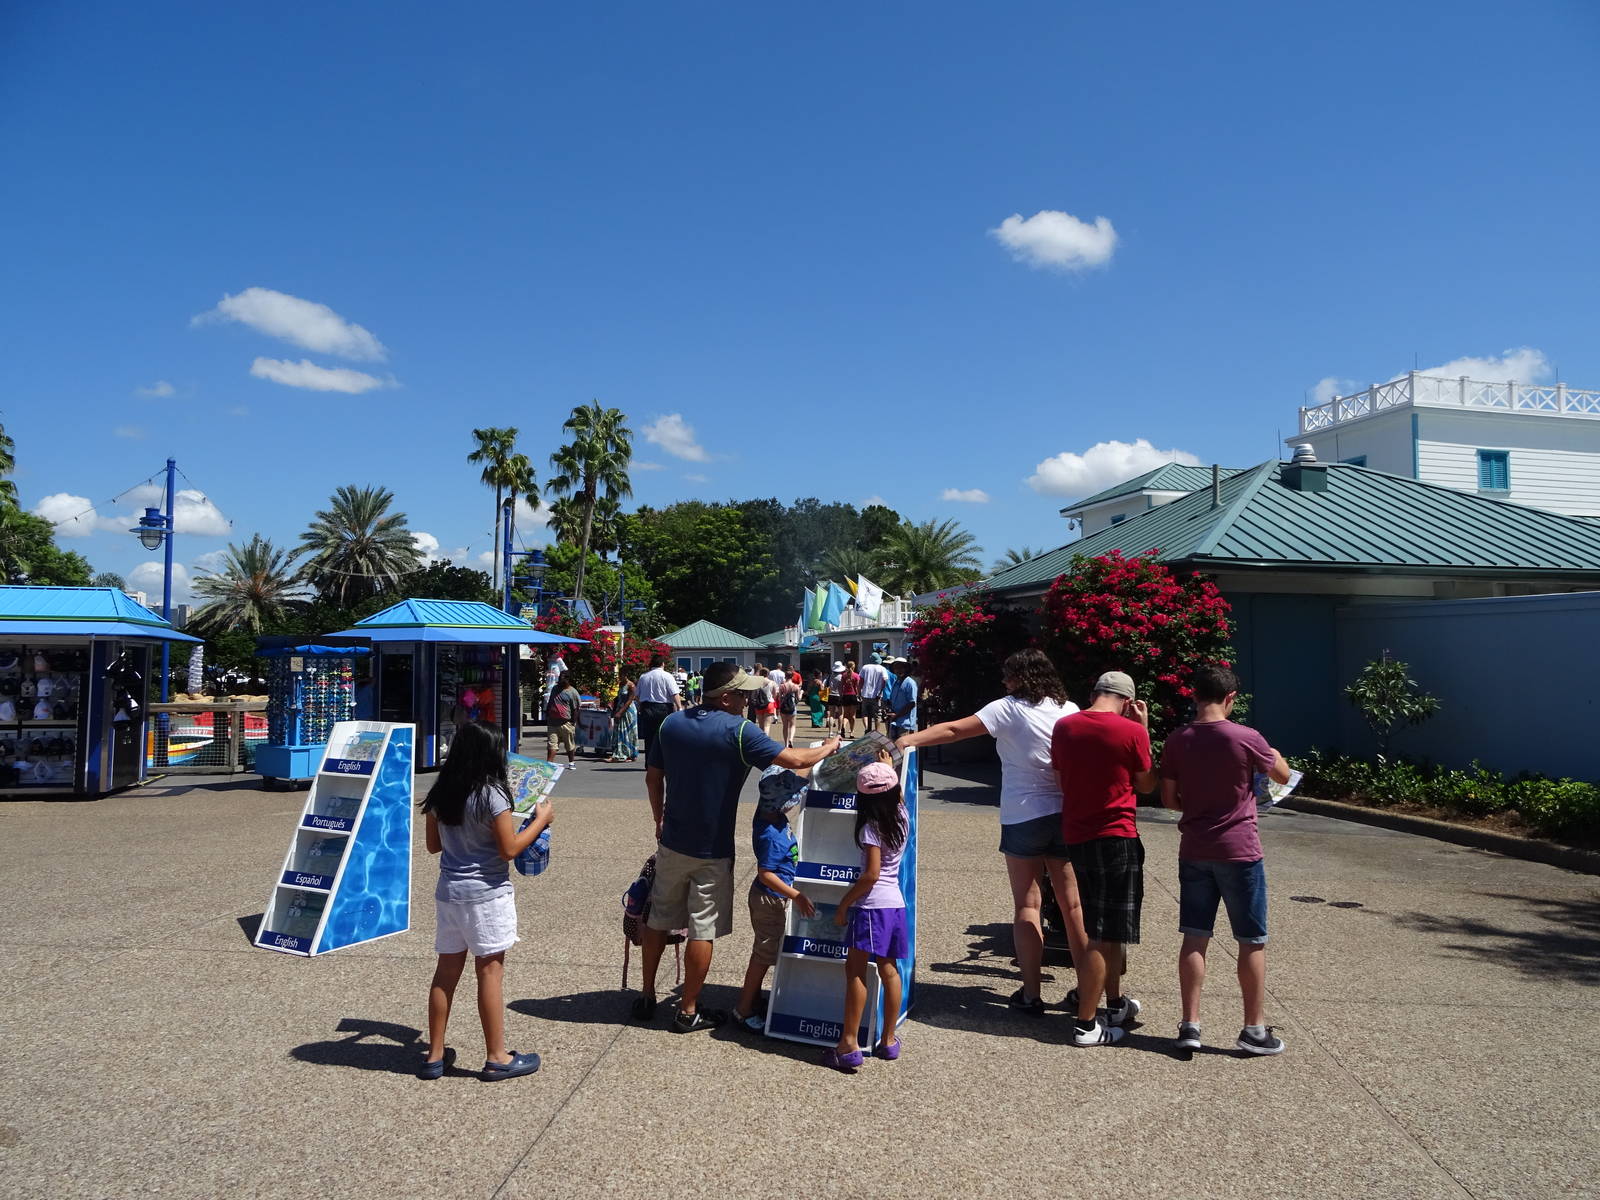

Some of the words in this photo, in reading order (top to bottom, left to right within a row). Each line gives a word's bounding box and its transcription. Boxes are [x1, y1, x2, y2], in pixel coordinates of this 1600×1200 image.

[338, 760, 361, 772] English
[831, 793, 856, 808] Engl
[295, 873, 322, 886] Español
[820, 865, 860, 880] Españo
[274, 935, 298, 948] English
[803, 939, 849, 957] Portugu
[799, 1019, 841, 1038] English
